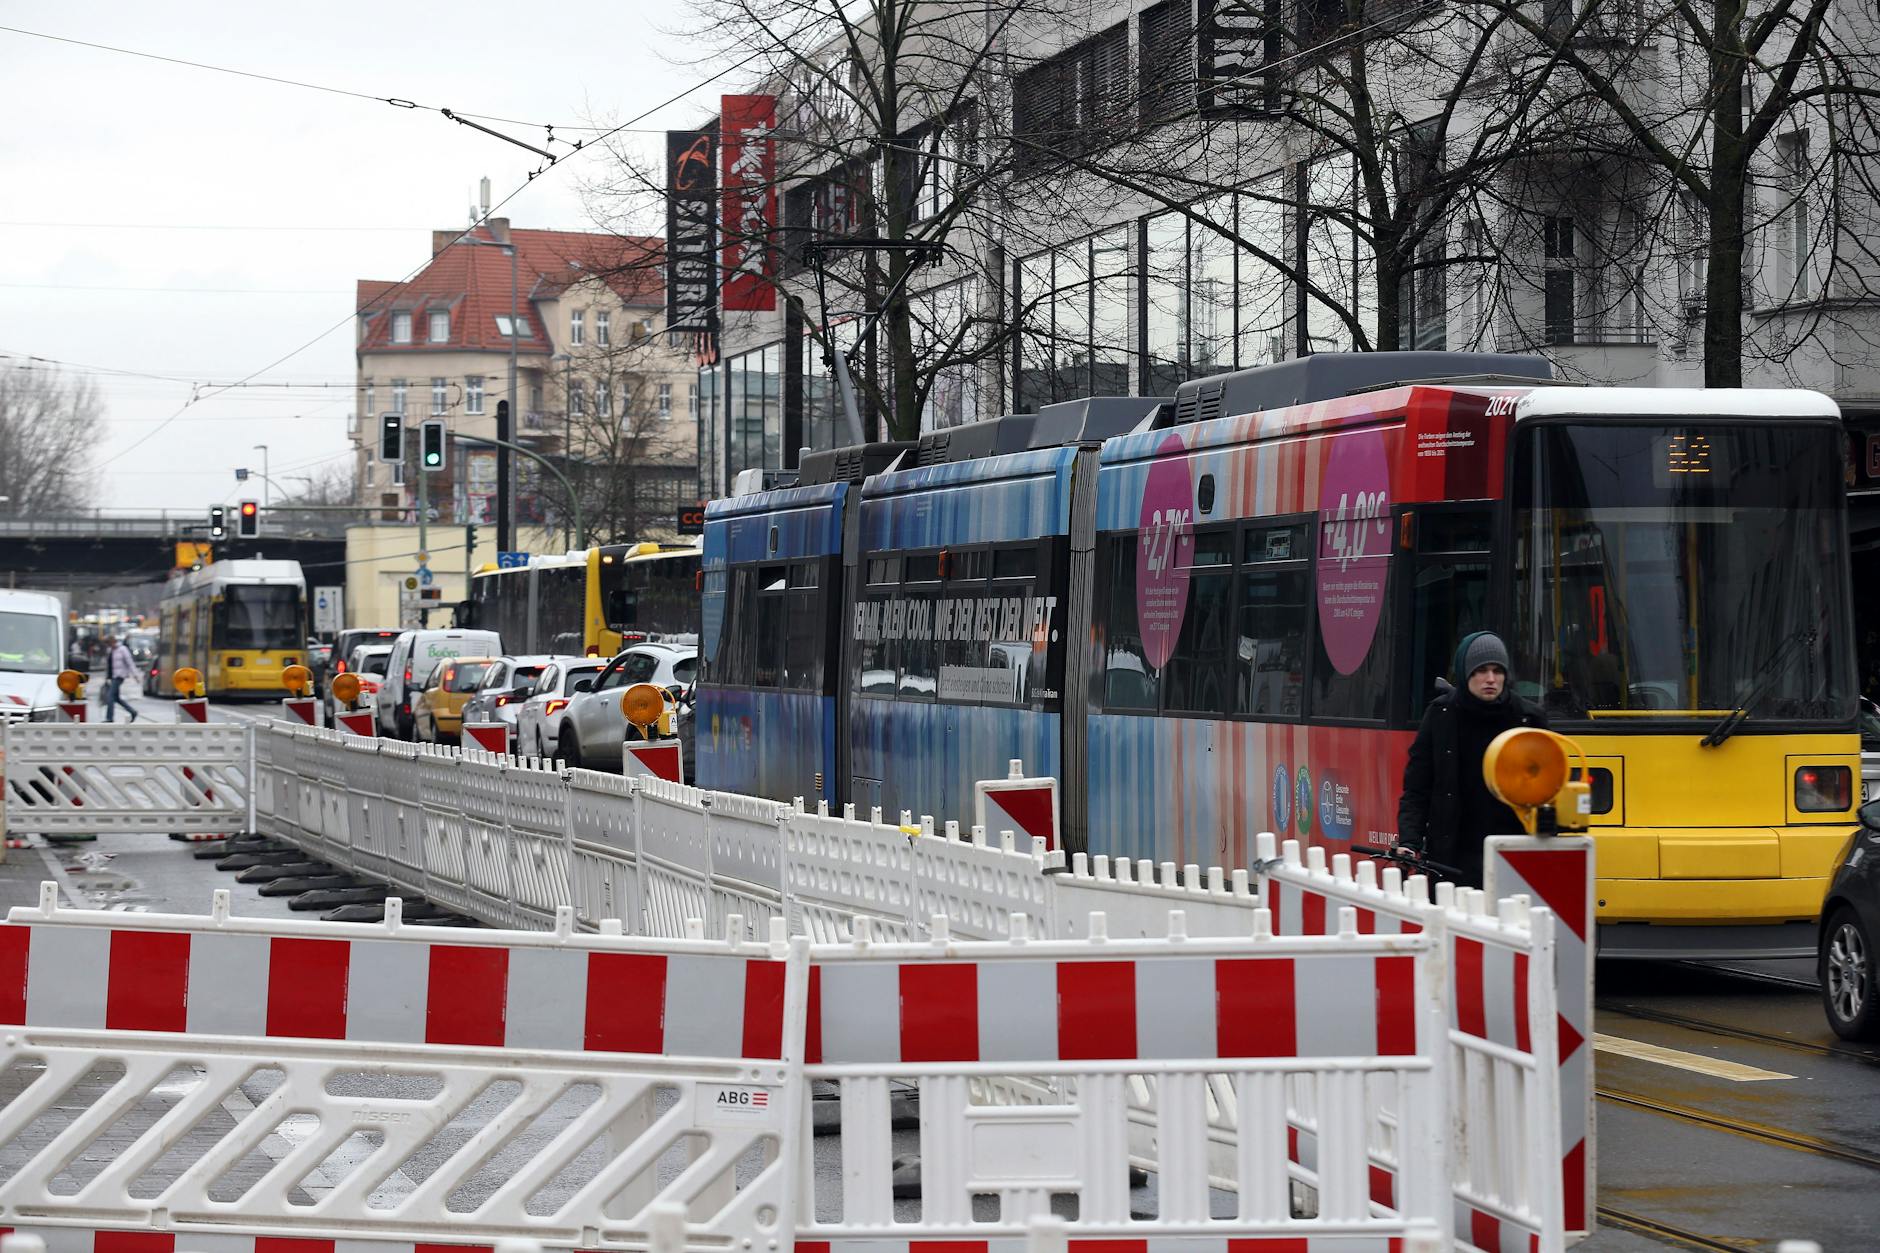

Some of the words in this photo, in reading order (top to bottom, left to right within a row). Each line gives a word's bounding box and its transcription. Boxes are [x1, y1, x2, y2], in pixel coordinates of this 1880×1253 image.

[675, 199, 708, 327] SATURN
[1485, 396, 1519, 416] 2021
[934, 599, 954, 641] WIE
[953, 598, 974, 641] DER
[974, 597, 1001, 641] REST
[999, 597, 1022, 641] DER
[1022, 596, 1059, 642] WELT.
[717, 1090, 749, 1105] ABG
